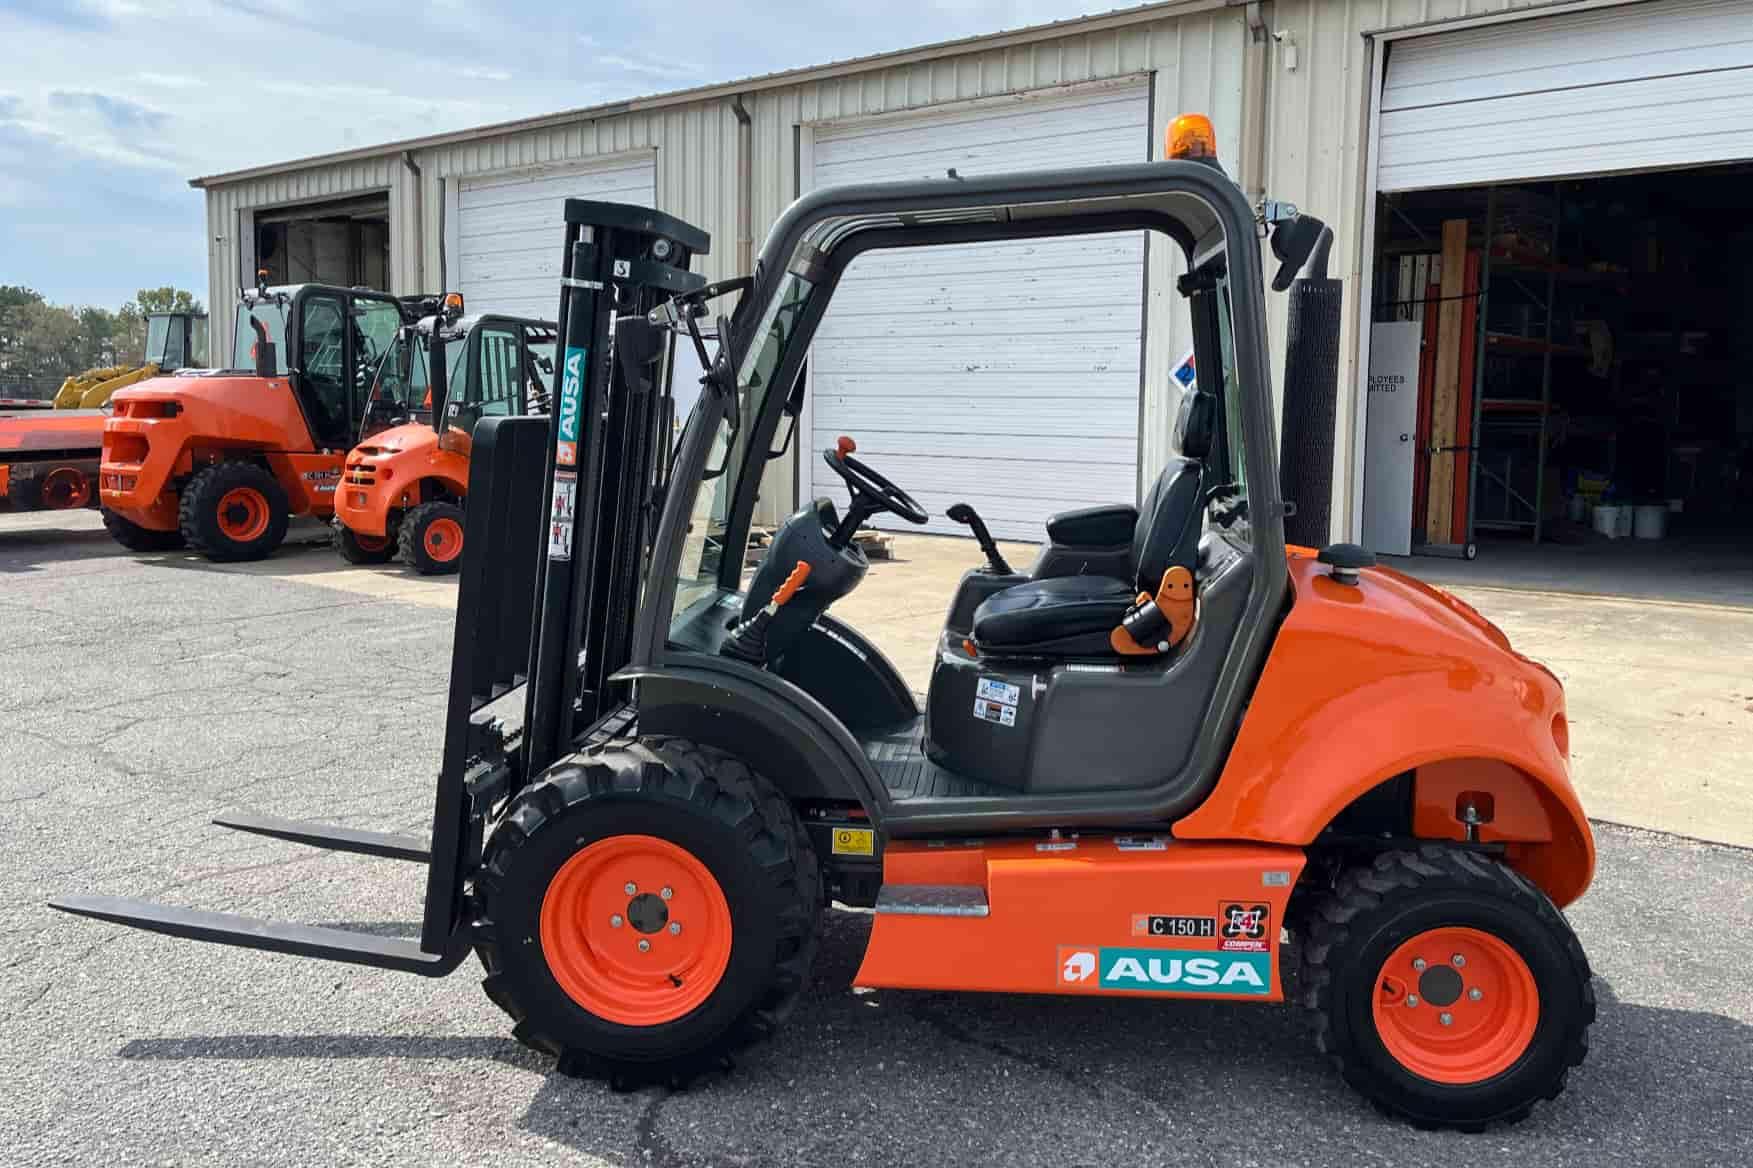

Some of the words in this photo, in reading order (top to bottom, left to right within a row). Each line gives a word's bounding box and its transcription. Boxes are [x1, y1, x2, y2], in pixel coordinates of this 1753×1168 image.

[562, 353, 581, 439] AUSA
[1152, 918, 1164, 934] C
[1169, 919, 1195, 935] 150
[1200, 919, 1211, 936] H
[1105, 957, 1265, 987] AUSA
